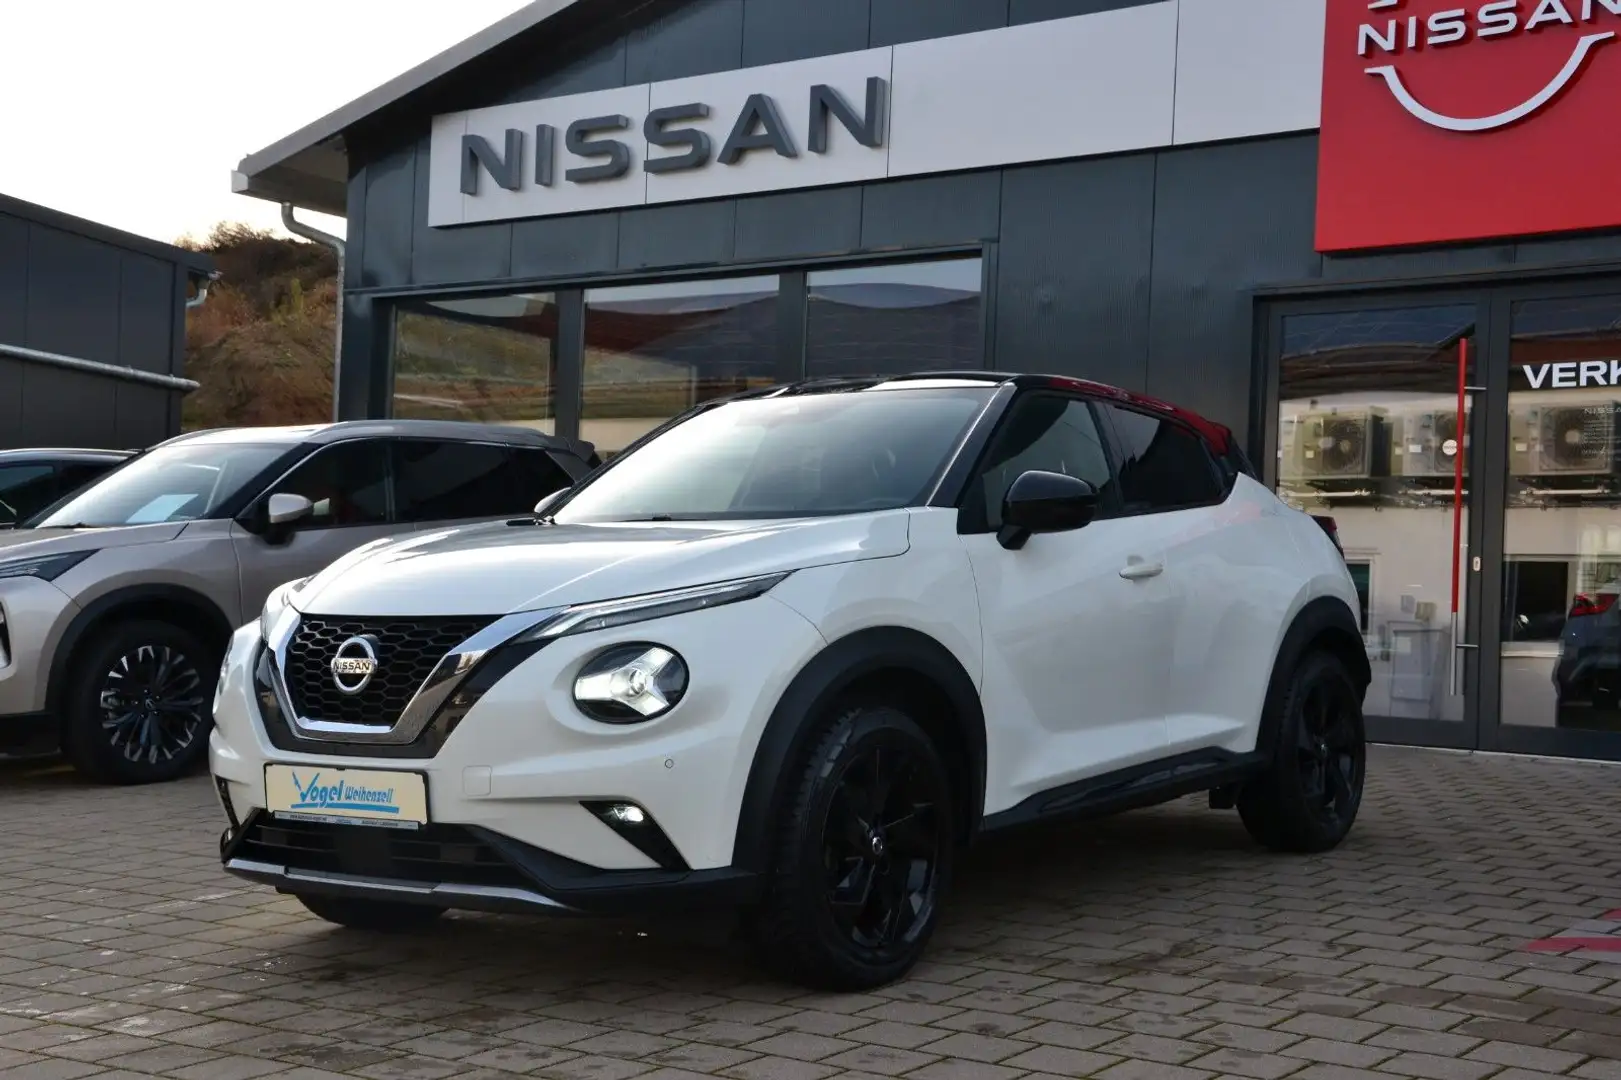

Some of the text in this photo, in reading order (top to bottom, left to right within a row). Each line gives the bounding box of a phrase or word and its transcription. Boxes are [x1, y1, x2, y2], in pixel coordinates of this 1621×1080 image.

[1357, 0, 1621, 56] NISSAN
[460, 76, 886, 195] NISSAN
[333, 660, 372, 671] NISSAN
[292, 771, 394, 807] Vogel Weihenzell
